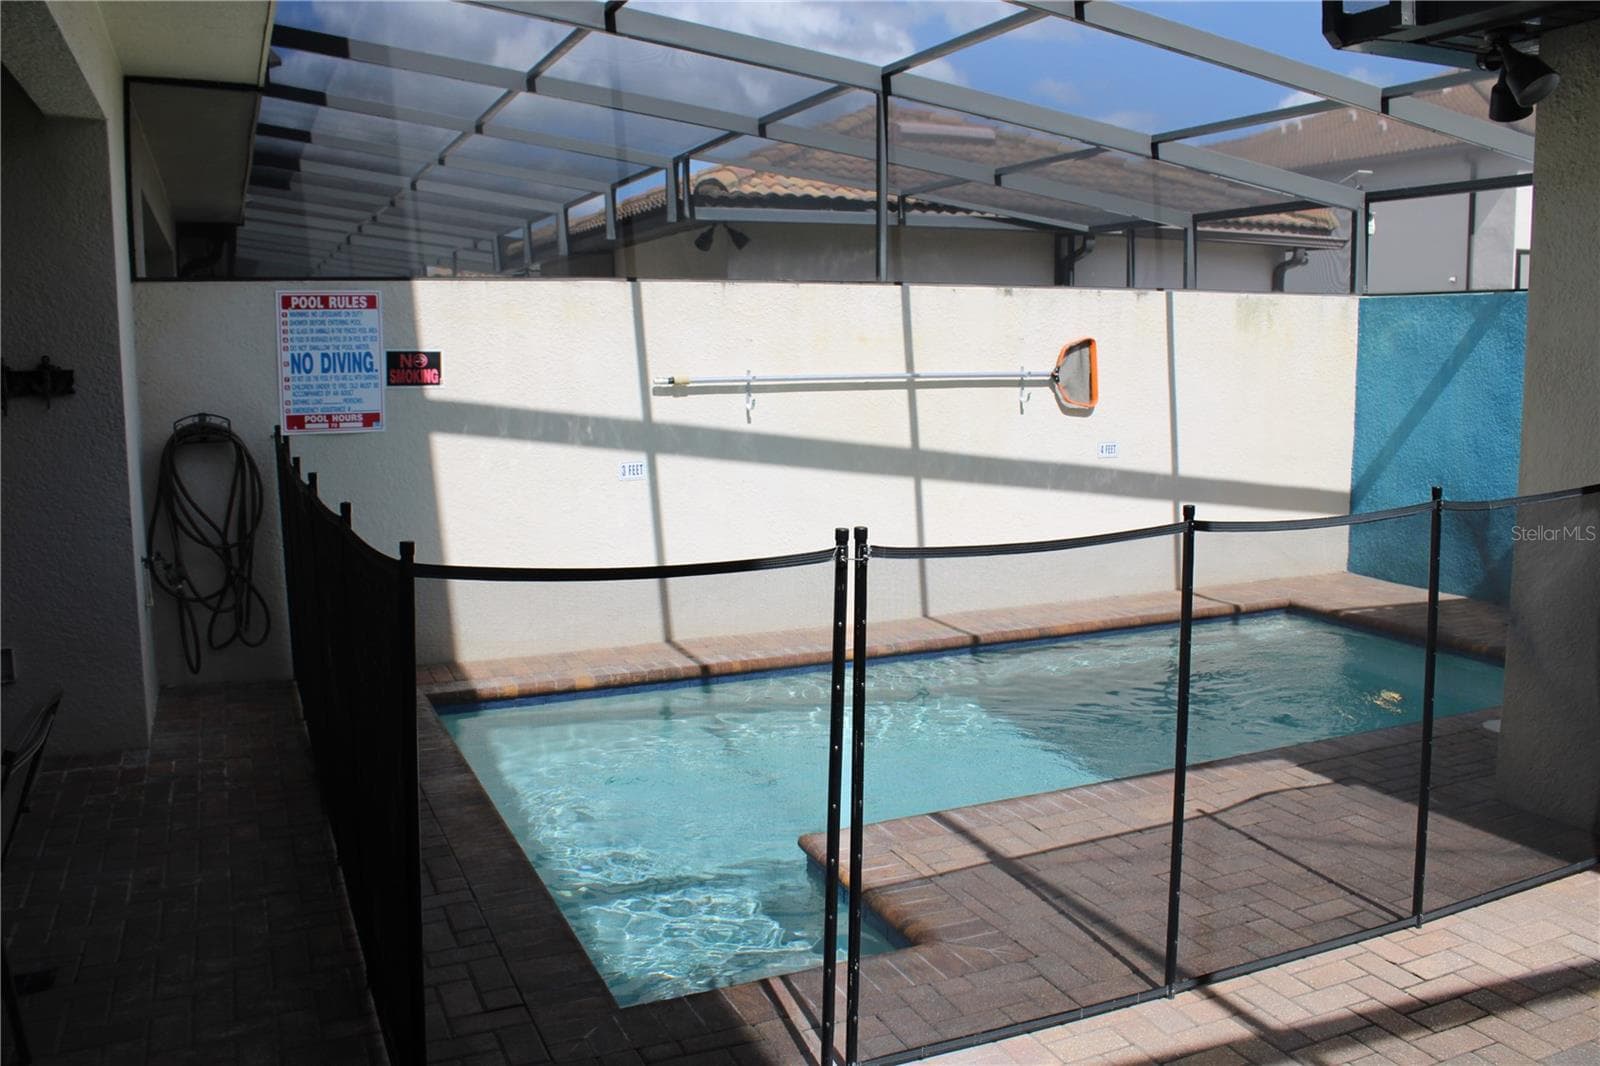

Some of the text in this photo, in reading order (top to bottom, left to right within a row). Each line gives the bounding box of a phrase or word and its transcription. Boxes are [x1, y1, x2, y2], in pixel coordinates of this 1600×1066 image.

[291, 296, 368, 309] POOL RULES
[291, 351, 379, 374] NO DIVING.
[390, 368, 440, 384] SMOKING
[304, 413, 363, 423] POOL HOURS
[628, 463, 643, 476] FEET
